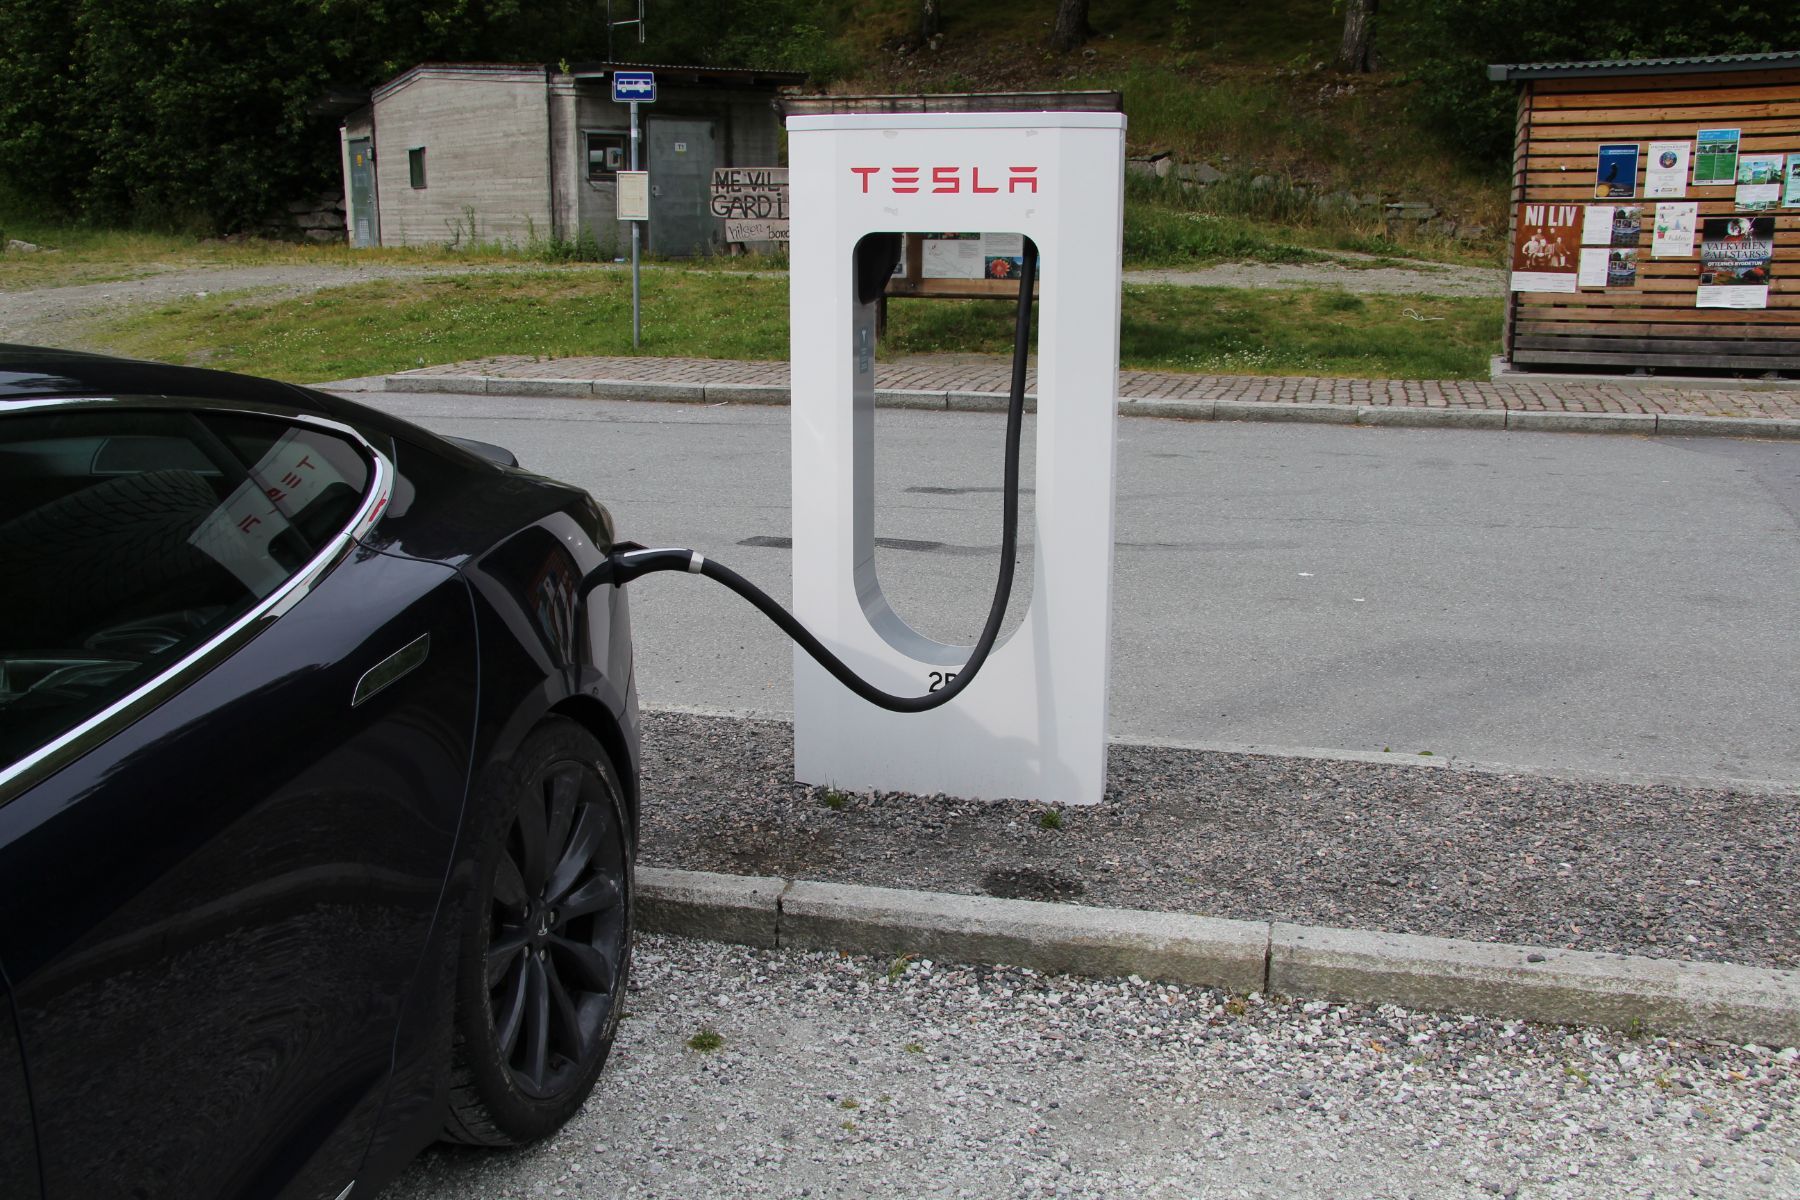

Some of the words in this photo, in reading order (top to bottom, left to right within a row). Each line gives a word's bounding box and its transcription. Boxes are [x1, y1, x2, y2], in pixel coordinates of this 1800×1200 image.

[714, 171, 742, 194] ME
[747, 171, 780, 192] VIL
[850, 166, 1038, 193] TESLA
[1524, 205, 1545, 226] NI
[1547, 205, 1577, 227] LIV
[1706, 241, 1767, 250] VALKYRIEN
[1711, 250, 1760, 258] ALLSTARS
